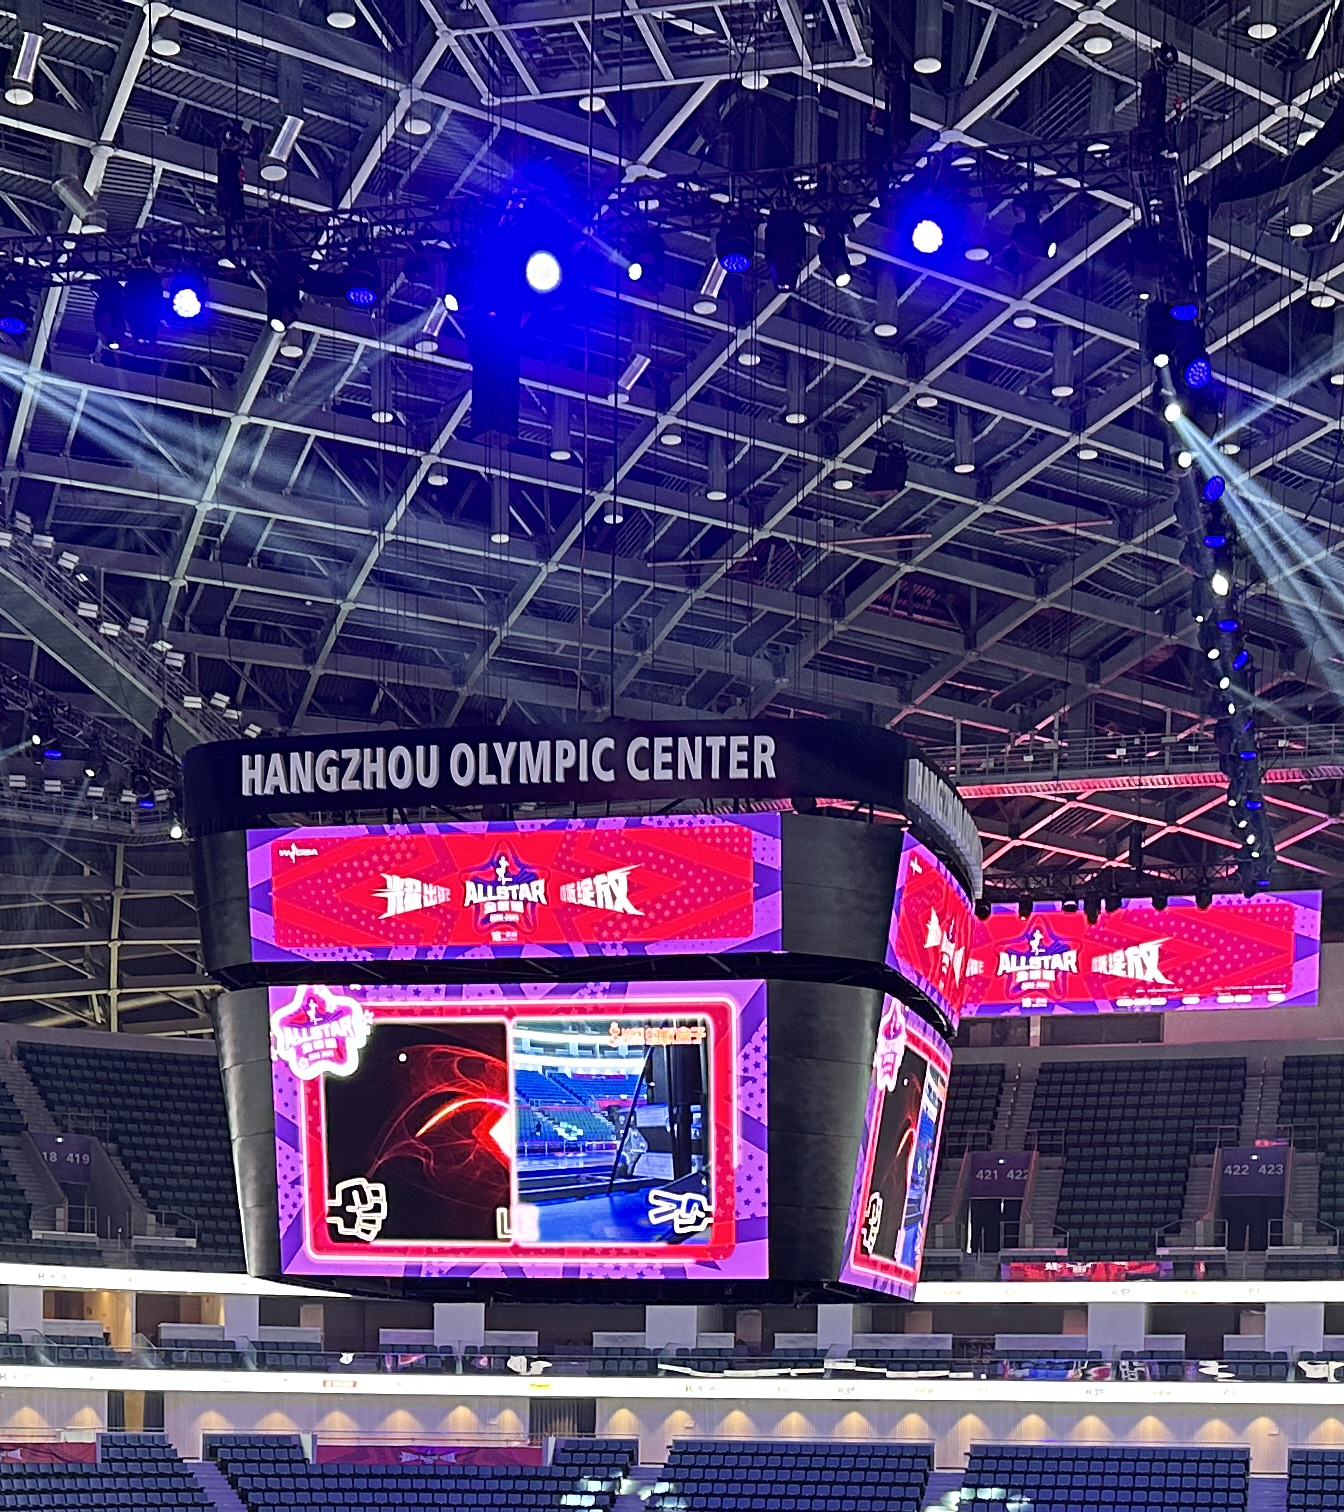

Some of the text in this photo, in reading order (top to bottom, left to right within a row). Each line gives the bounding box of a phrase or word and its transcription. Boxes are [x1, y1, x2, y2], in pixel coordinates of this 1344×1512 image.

[241, 734, 777, 796] HANGZHOU OLYMPIC CENTER
[464, 878, 548, 907] ALLSTAR
[997, 950, 1080, 976] ALLSTAR
[282, 1015, 357, 1050] ALLSTAR
[41, 1151, 90, 1165] 18 419
[1224, 1163, 1284, 1176] 422 423
[975, 1168, 999, 1181] 421
